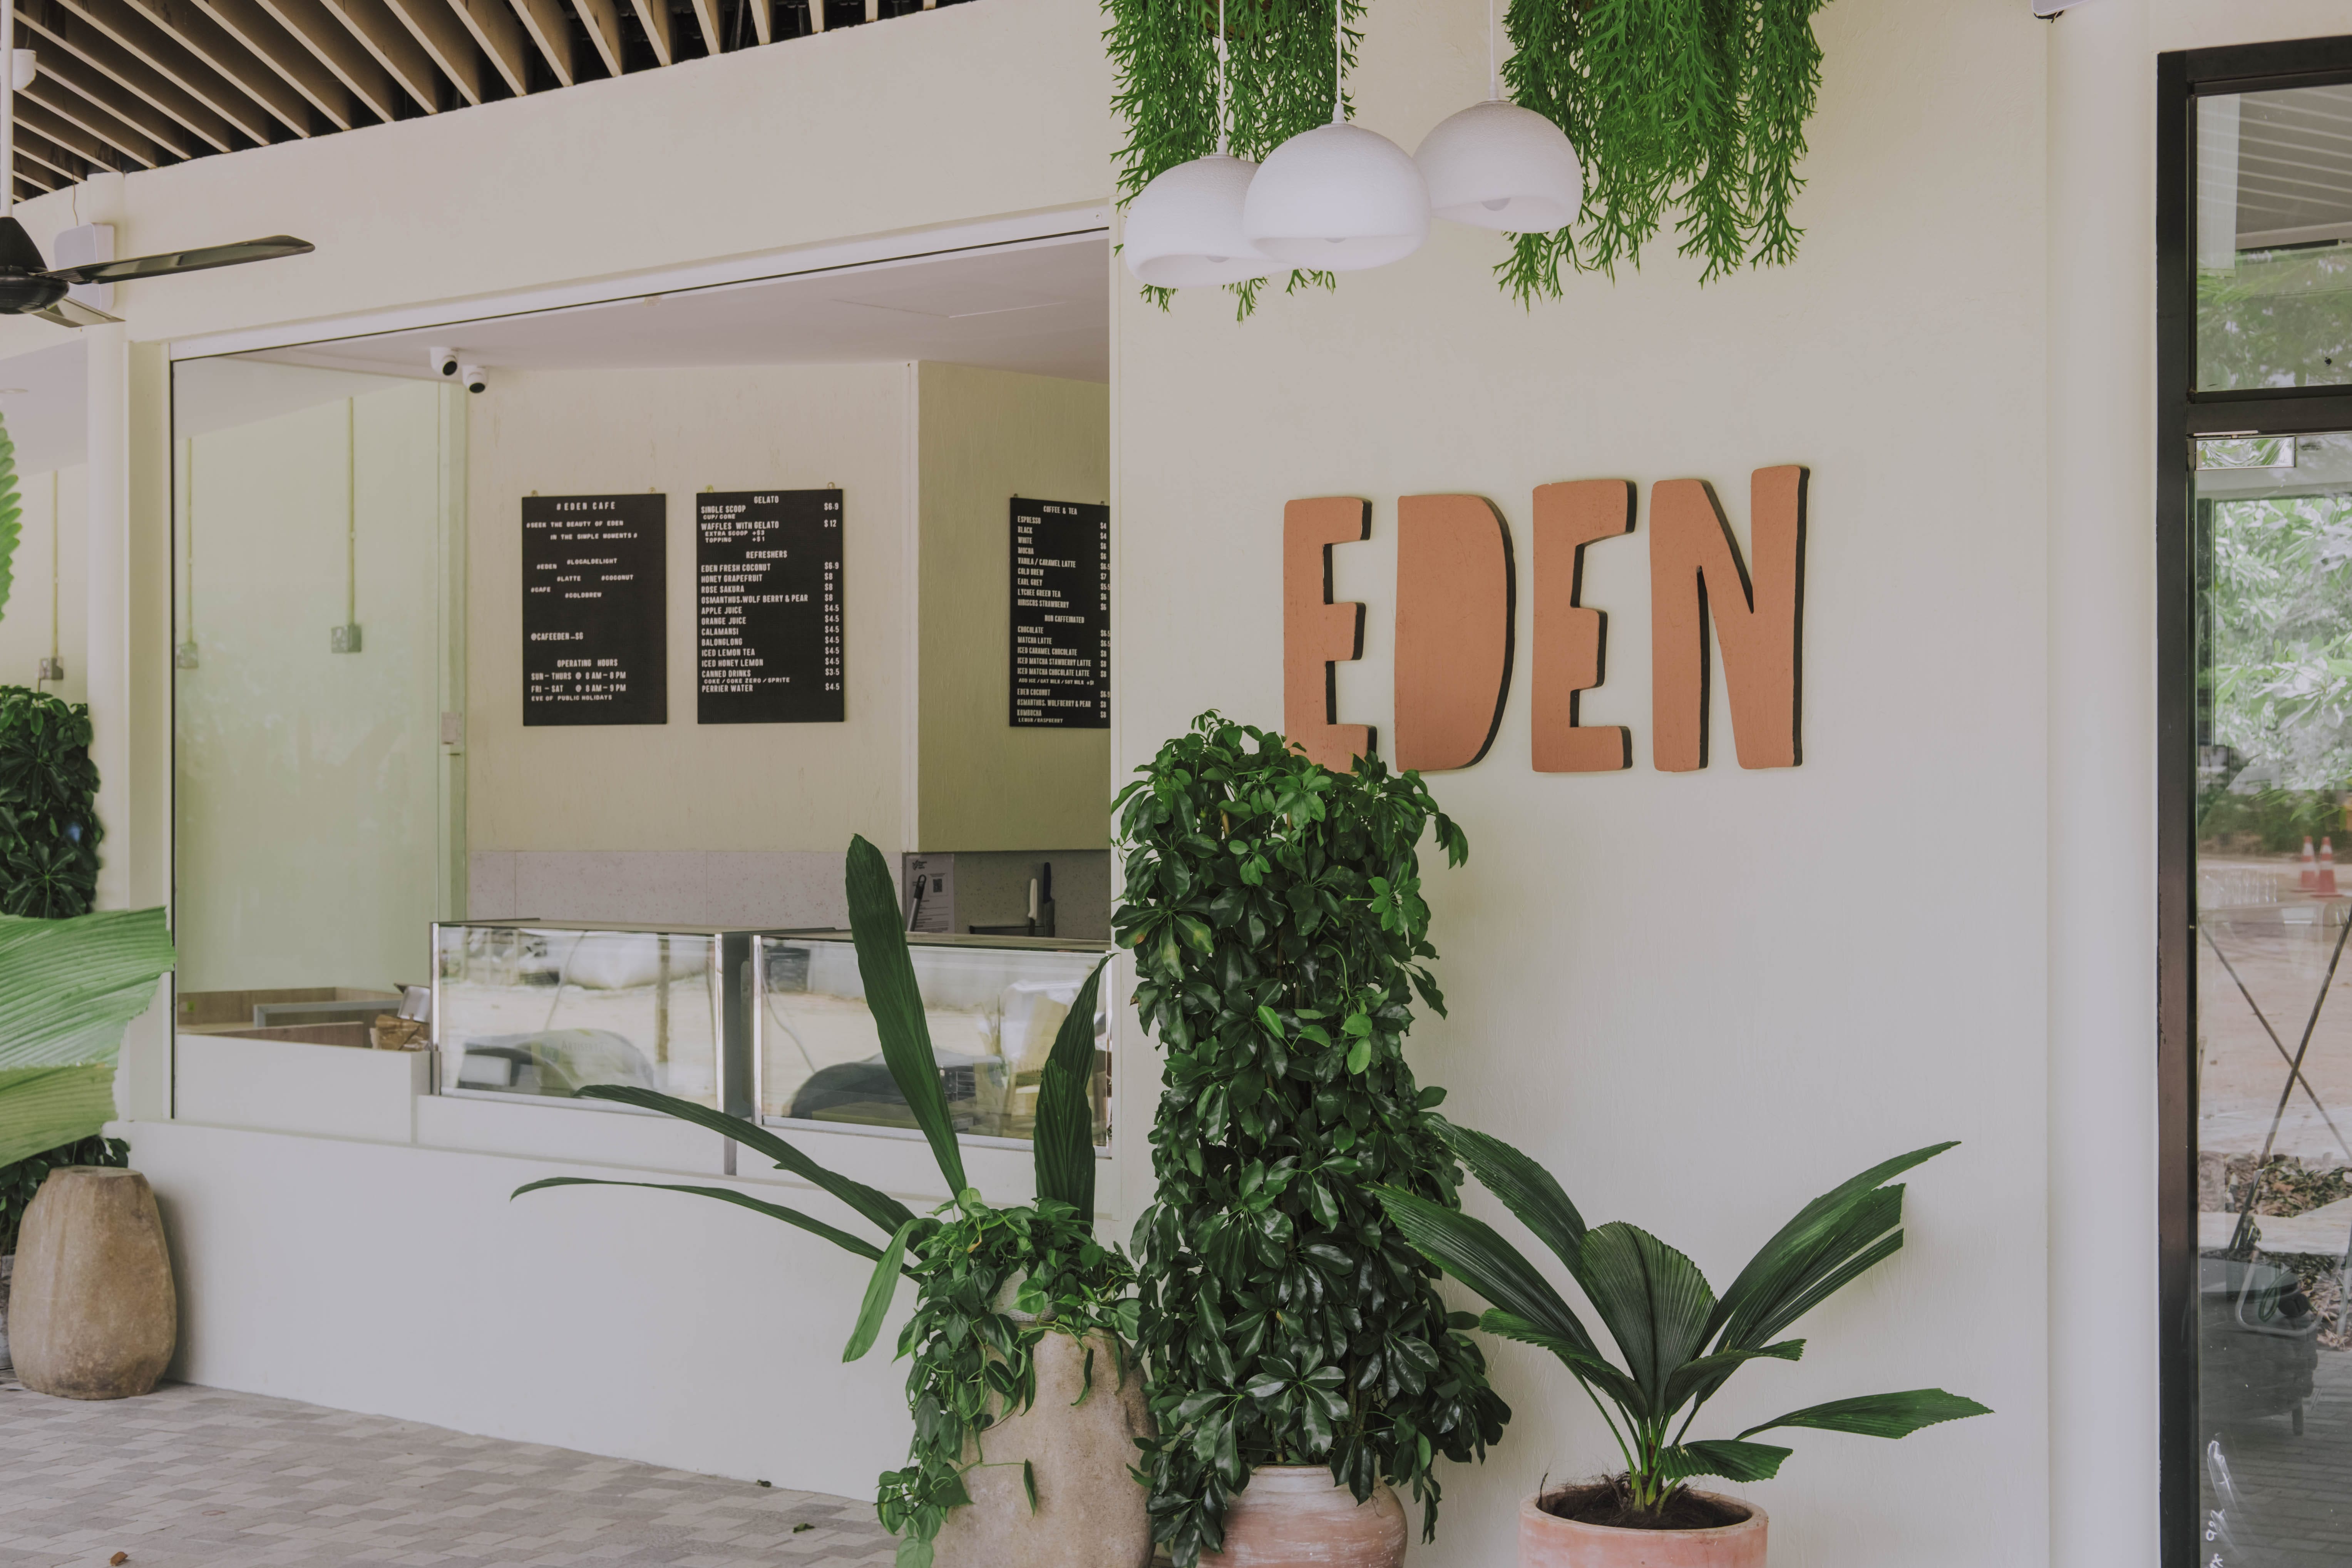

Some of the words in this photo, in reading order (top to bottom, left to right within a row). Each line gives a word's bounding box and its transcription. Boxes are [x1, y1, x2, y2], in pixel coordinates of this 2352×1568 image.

[754, 495, 779, 504] GELATO
[564, 502, 587, 511] EDEN
[593, 501, 615, 510] CAFE
[701, 505, 723, 514] SINGLE
[725, 505, 746, 513] SCOOP
[1043, 505, 1060, 514] COFFEE
[1018, 515, 1041, 524] ESPRESSO
[701, 522, 732, 530] WAFFLES
[754, 521, 779, 529] GELATO
[1018, 526, 1033, 534] BLACK
[1018, 536, 1032, 544] WHITE
[746, 550, 787, 559] REFRESHERS
[1018, 547, 1034, 555] MOCHA
[701, 564, 718, 572] EDEN
[719, 564, 740, 572] FRESH
[742, 563, 771, 572] COCONUT
[1039, 559, 1061, 567] CARAMEL
[701, 575, 722, 583] HONEY
[723, 574, 762, 582] GRAPEFRUIT
[824, 572, 833, 581] $8
[701, 586, 717, 594] ROSE
[720, 585, 745, 593] SAKURA
[824, 583, 833, 591] $8
[1018, 588, 1035, 596] LYCHEE
[762, 595, 783, 603] BERRY
[791, 594, 808, 602] PEAR
[825, 593, 833, 602] $8
[1039, 600, 1069, 608] STRAWBERRY
[724, 606, 742, 614] JUICE
[701, 617, 726, 625] ORANGE
[728, 616, 746, 625] JUICE
[1055, 615, 1085, 623] CAFFEINATED
[1283, 465, 1810, 772] EDEN
[701, 628, 738, 636] CALAMANSI
[1018, 626, 1044, 634] CHOCOLATE
[701, 638, 743, 646] BALONGLONG
[718, 649, 741, 657] LEMON
[1051, 648, 1077, 656] CHOCOLATE
[557, 659, 591, 668] OPERATING
[597, 659, 618, 667] HOURS
[701, 659, 716, 668] ICED
[740, 659, 763, 667] LEMON
[701, 670, 727, 678] CANNED
[728, 669, 751, 678] DRINKS
[551, 684, 563, 693] SAT
[702, 684, 728, 693] PERRIER
[730, 684, 753, 692] WATER
